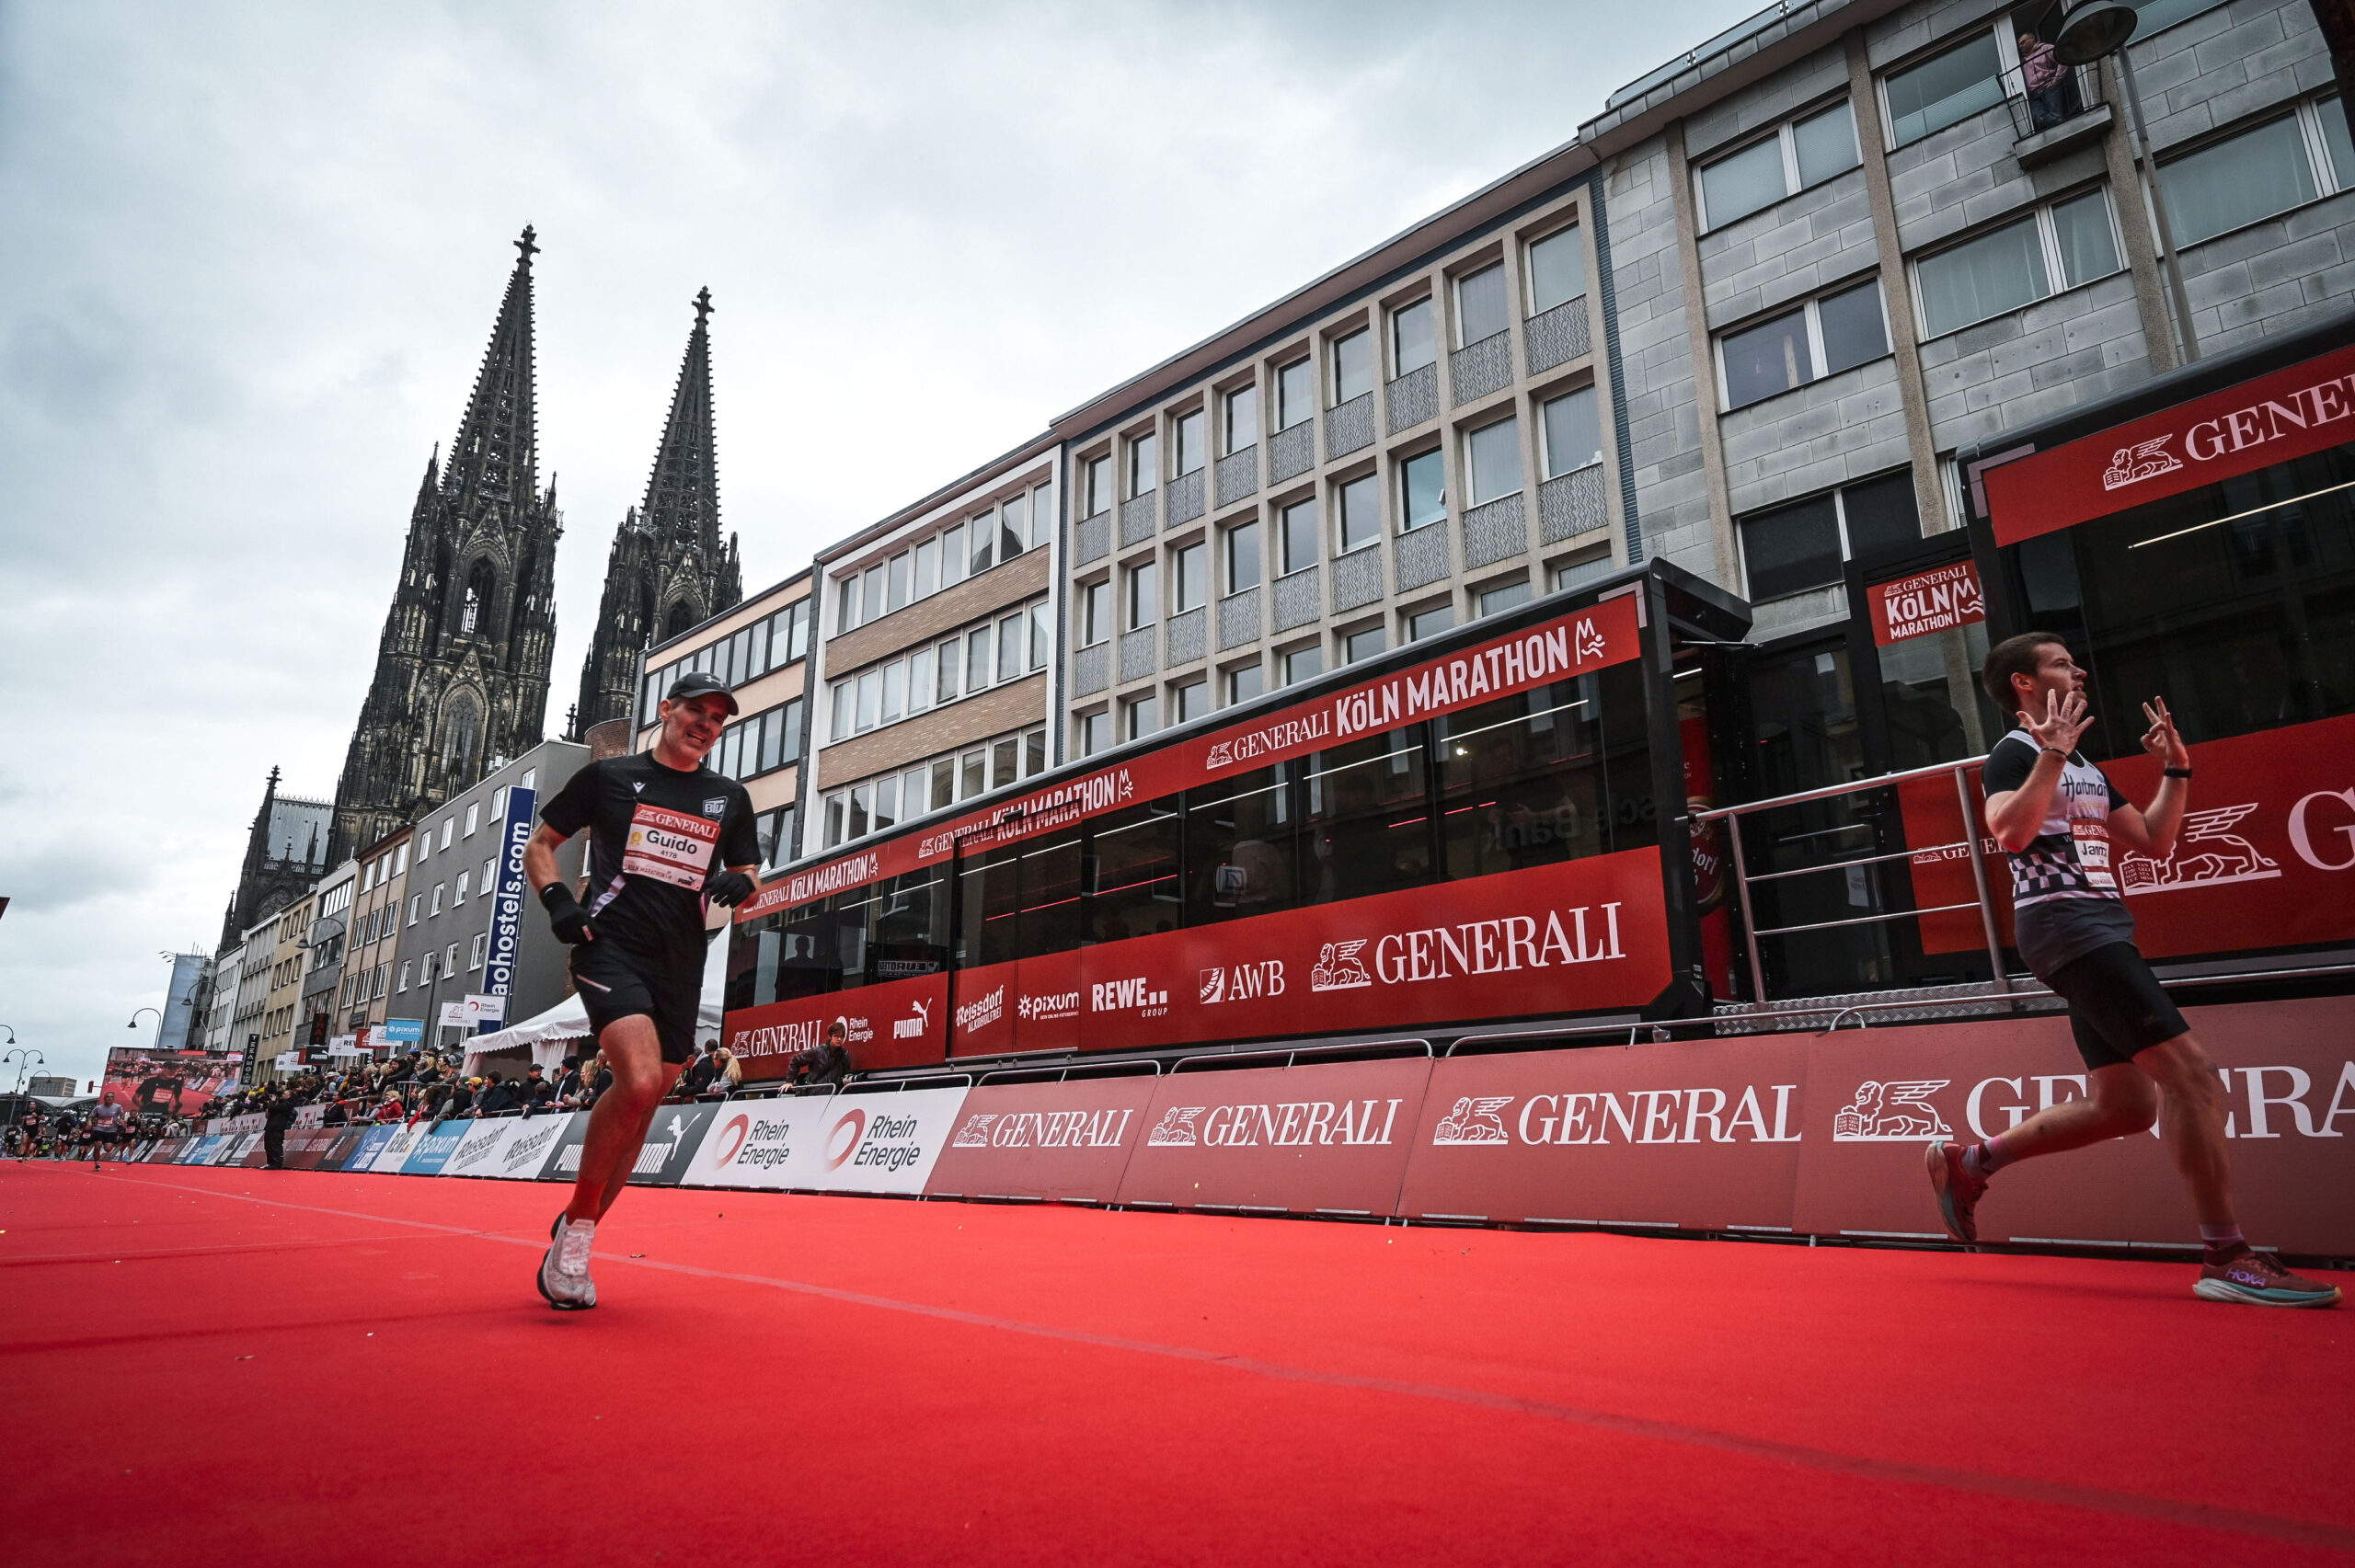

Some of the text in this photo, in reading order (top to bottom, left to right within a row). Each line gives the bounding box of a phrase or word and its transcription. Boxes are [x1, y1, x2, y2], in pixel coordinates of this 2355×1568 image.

[2185, 373, 2355, 461] GENE
[1902, 565, 1968, 592] GENERALI
[1885, 582, 1951, 625] KÖLN
[1890, 612, 1953, 640] MARATHON
[1234, 624, 1569, 761] GENERALI KÖLN MARATHON
[655, 812, 718, 839] GENERALI
[646, 829, 697, 855] Guido
[661, 849, 678, 860] 4178
[790, 871, 814, 903] KÖLN
[814, 854, 868, 896] MARATHON
[489, 821, 530, 995] aohostels.com
[1374, 901, 1626, 986] GENERALI
[1227, 959, 1286, 1001] AWB
[956, 983, 1005, 1028] Reissdorf
[1032, 990, 1080, 1021] pixum
[1092, 977, 1147, 1013] REWE
[849, 1016, 868, 1029] Rhein
[967, 1006, 1003, 1034] ALKOHOLFREI
[1141, 1007, 1168, 1018] GROUP
[751, 1019, 822, 1058] GENERALI
[848, 1028, 874, 1043] Energie
[893, 1017, 924, 1040] PUMA
[749, 1118, 789, 1141] Rhein
[867, 1115, 917, 1139] Rhein
[992, 1108, 1133, 1148] GENERALI
[1203, 1098, 1403, 1146] GENERALI
[417, 1134, 461, 1163] pixum
[737, 1143, 790, 1171] Energie
[854, 1141, 921, 1173] Energie
[2224, 1267, 2268, 1287] HOKA
